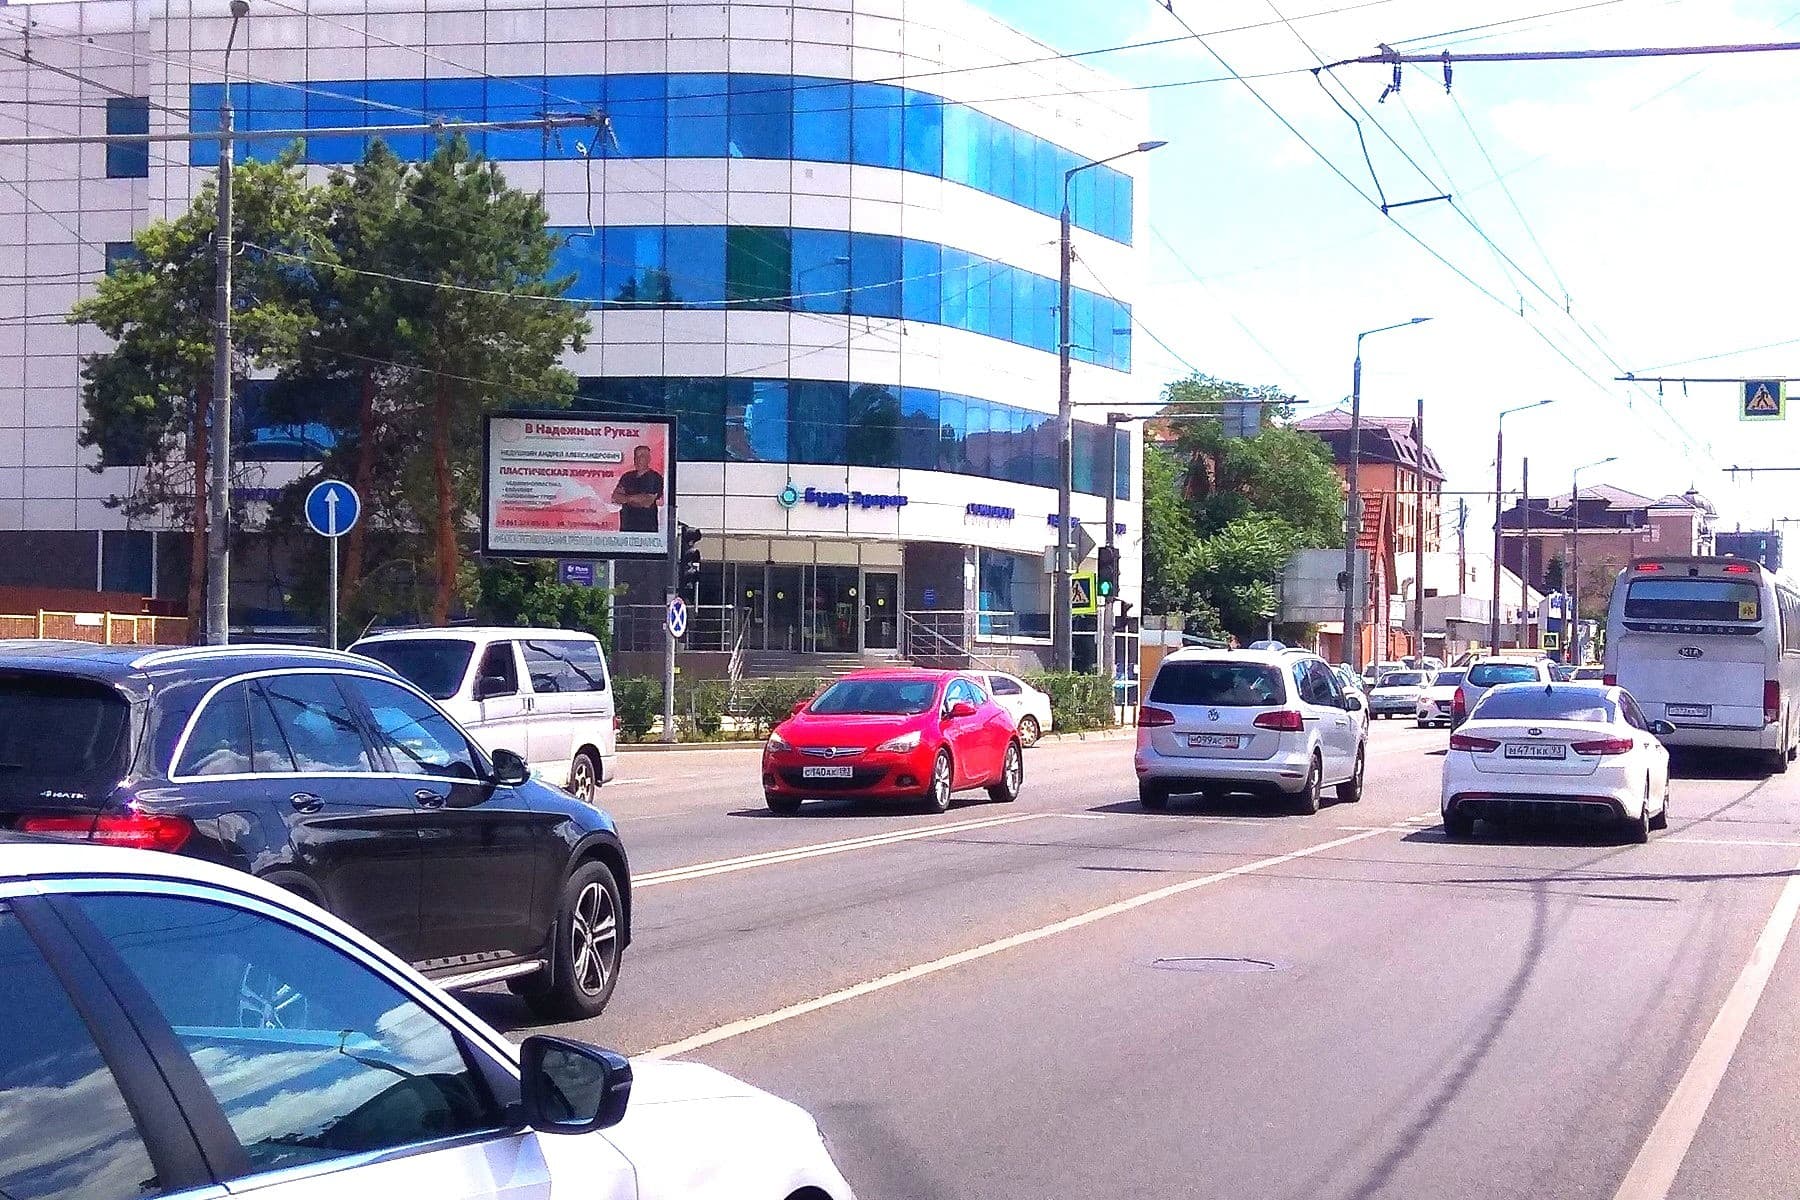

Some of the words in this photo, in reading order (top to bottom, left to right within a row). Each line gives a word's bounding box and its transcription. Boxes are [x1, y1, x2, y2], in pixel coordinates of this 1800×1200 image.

[525, 423, 533, 434] В
[536, 424, 602, 437] Надежных
[604, 426, 640, 439] Руках
[499, 466, 569, 478] ПЛАСТИЧЕСКАЯ
[570, 468, 615, 479] ХИРУРГИЯ
